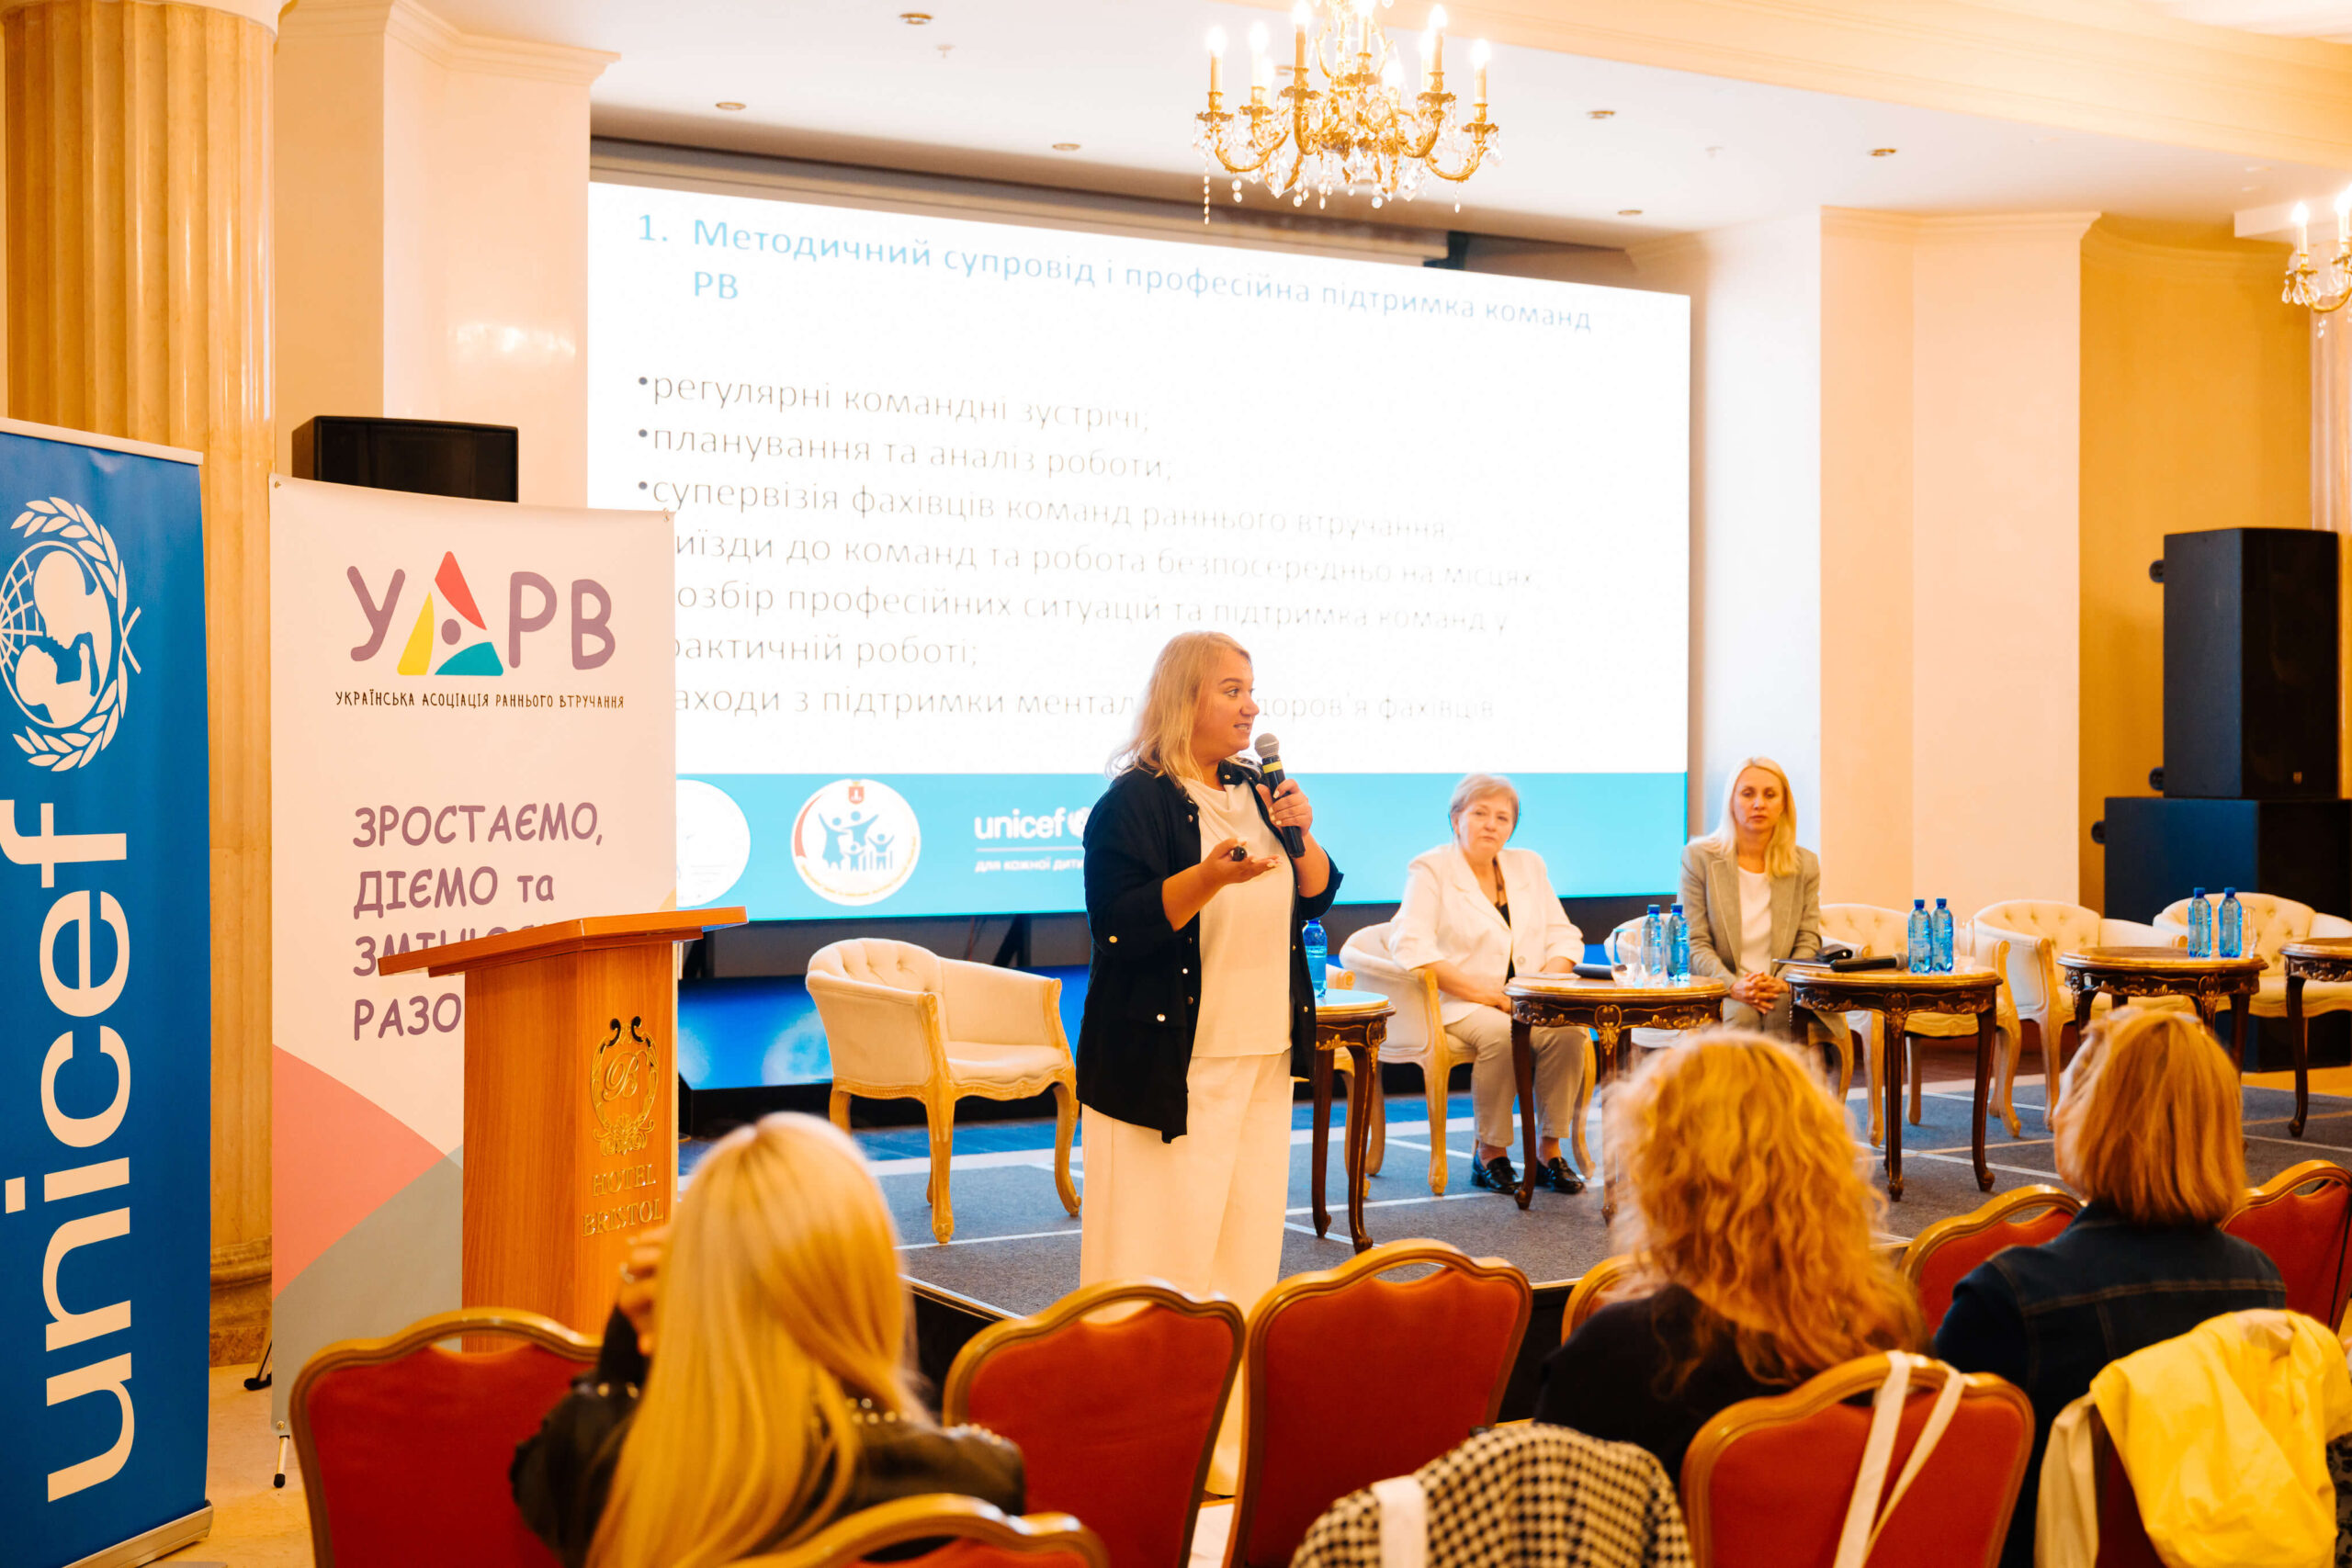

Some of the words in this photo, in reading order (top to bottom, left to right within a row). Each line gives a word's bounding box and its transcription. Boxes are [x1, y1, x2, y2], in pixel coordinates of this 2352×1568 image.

[637, 214, 668, 243] 1.
[693, 218, 931, 267] Методичний
[944, 248, 1095, 287] супровід
[1106, 255, 1113, 284] і
[1125, 265, 1310, 303] професійна
[1323, 282, 1475, 318] підтримка
[1486, 299, 1591, 332] команд
[693, 270, 739, 299] РВ
[653, 375, 831, 412] регулярні
[845, 392, 1006, 423] командні
[1020, 400, 1149, 434] зустрічі;
[654, 426, 870, 461] планування
[884, 440, 917, 465] та
[930, 445, 1035, 472] аналіз
[1048, 449, 1173, 485] роботи;
[653, 479, 837, 512] супервізія
[852, 483, 995, 521] фахівців
[1008, 498, 1131, 528] команд
[1142, 503, 1287, 533] раннього
[676, 529, 773, 564] иїзди
[786, 538, 831, 566] до
[845, 540, 978, 570] команд
[991, 545, 1020, 569] та
[1033, 544, 1145, 575] робота
[1157, 547, 1392, 586] безпосередньо
[1403, 564, 1434, 584] на
[676, 580, 774, 617] озбір
[788, 585, 1011, 620] професійних
[1024, 592, 1161, 626] ситуацій
[1175, 600, 1204, 624] та
[1214, 602, 1369, 632] підтримка
[1378, 609, 1487, 635] команд
[674, 634, 842, 661] актичній
[856, 634, 978, 669] роботі;
[335, 689, 414, 706] УКРАЇНСЬКА
[422, 692, 489, 709] АСОЦІАЦІЯ
[495, 694, 553, 708] РАННЬОГО
[559, 694, 625, 710] ВТРУЧАННЯ
[674, 689, 779, 718] аходи
[793, 691, 808, 713] з
[823, 685, 1005, 720] підтримки
[353, 802, 603, 848] ЗРОСТАЄМО,
[974, 807, 1067, 840] unicef
[975, 860, 1001, 874] для
[353, 866, 498, 919] ДІЄМО
[516, 874, 555, 904] та
[354, 992, 462, 1041] РАЗО
[0, 799, 134, 1503] unicef
[593, 1164, 656, 1197] HOTEL
[582, 1198, 663, 1237] BRISTOL
